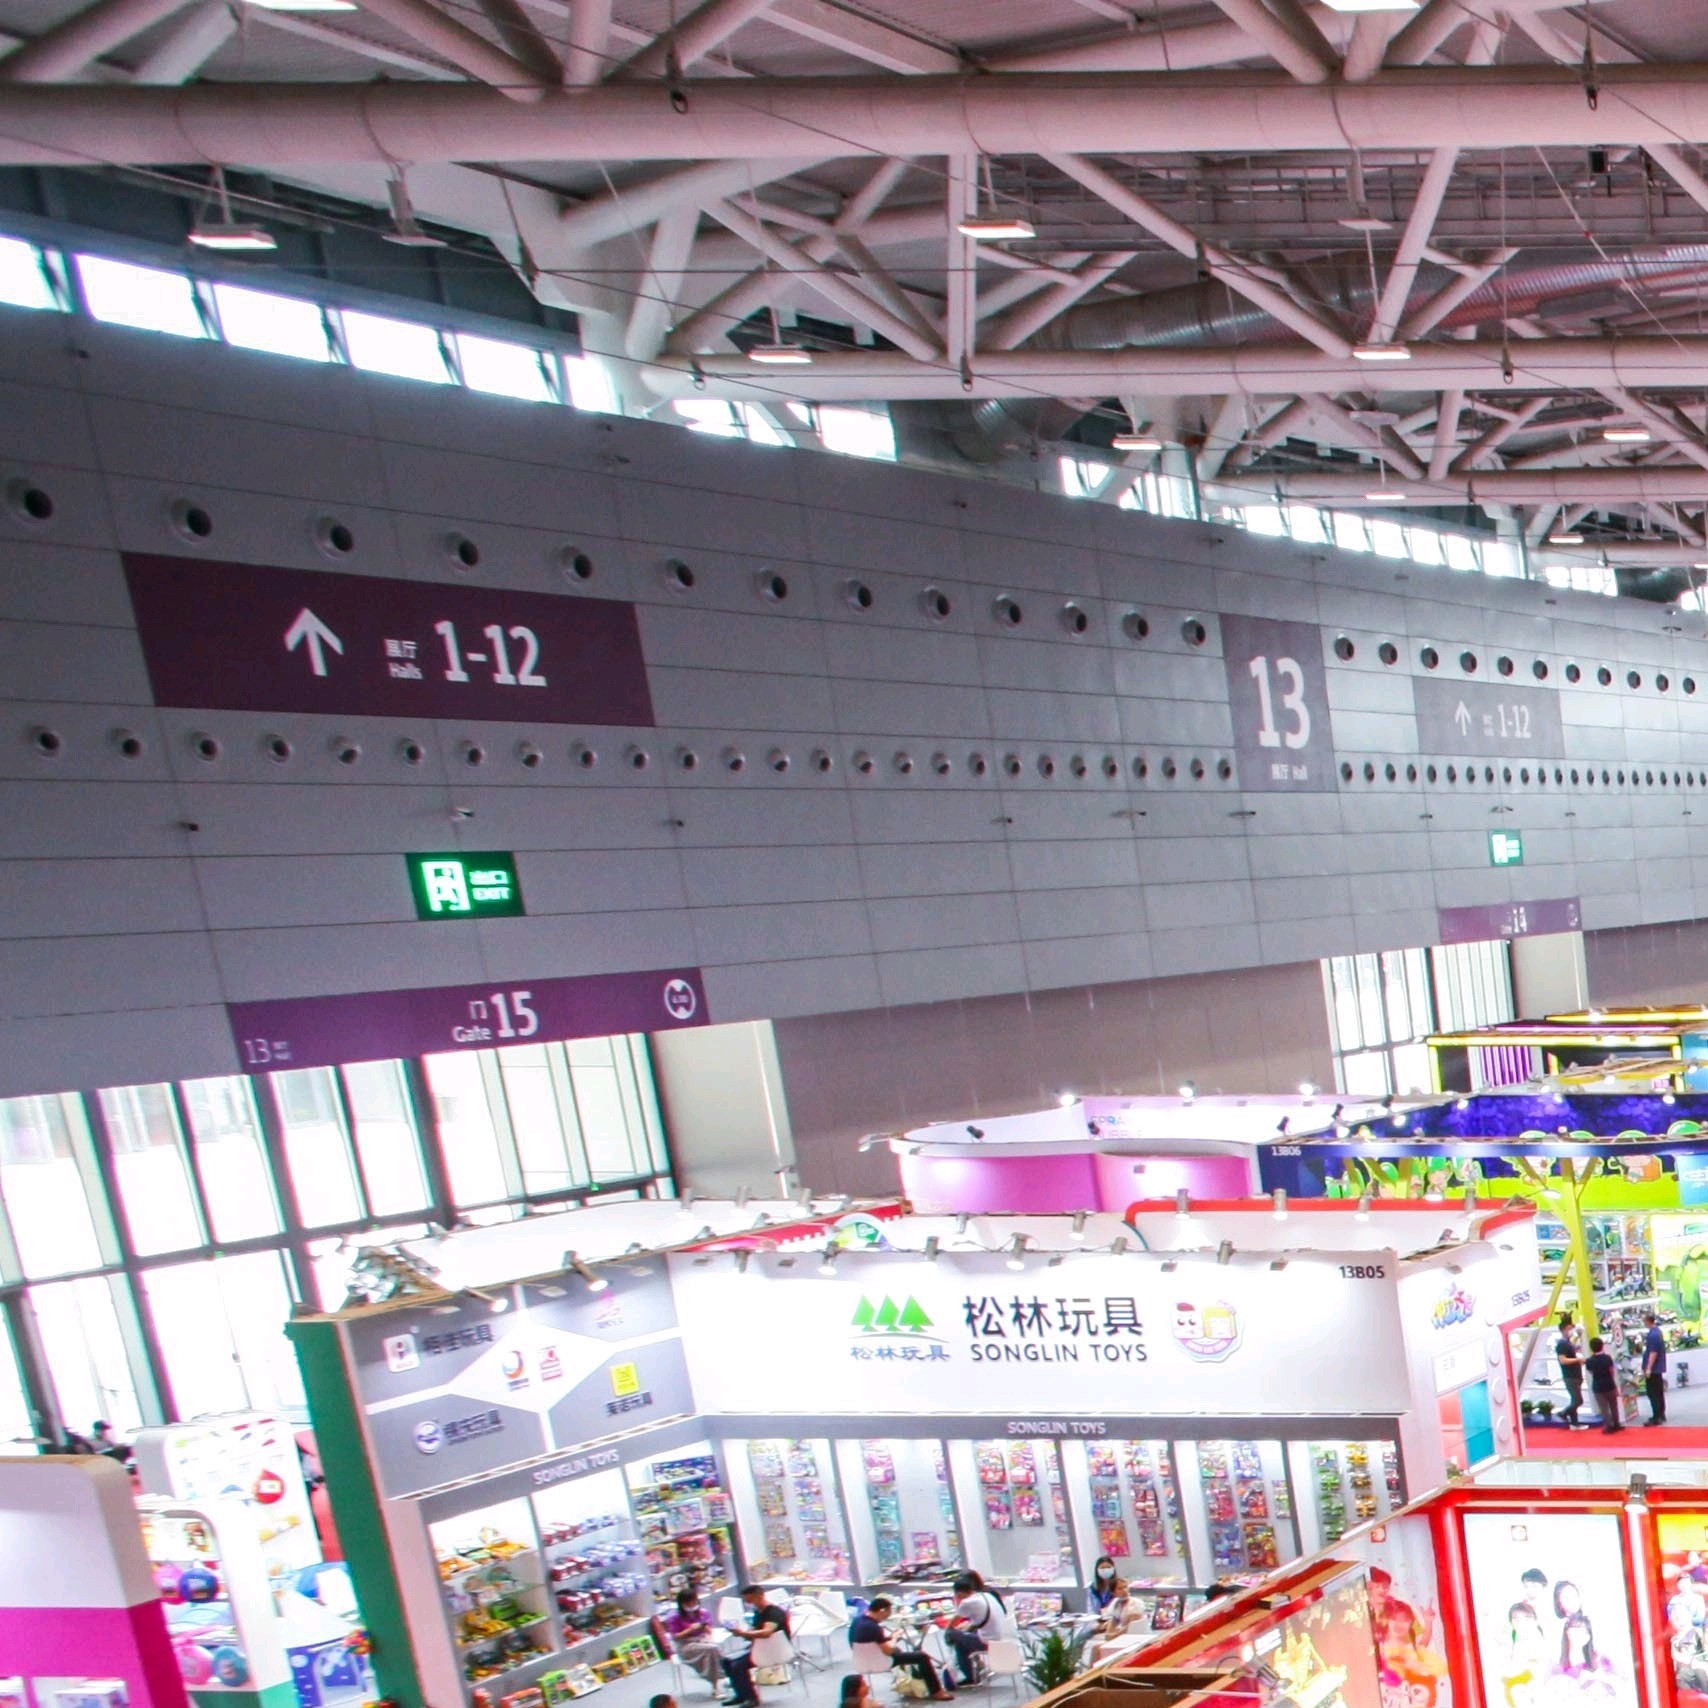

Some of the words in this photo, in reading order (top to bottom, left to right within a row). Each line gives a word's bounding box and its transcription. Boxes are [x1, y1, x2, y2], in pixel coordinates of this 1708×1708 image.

[436, 620, 548, 689] 1-12
[1249, 655, 1311, 751] 13
[1498, 703, 1532, 739] 1-12
[472, 886, 511, 902] EXIT
[453, 1024, 492, 1045] Gate
[496, 991, 540, 1040] 15
[1338, 1264, 1386, 1280] 13B05
[962, 1295, 1144, 1338] 松林玩具
[849, 1343, 951, 1362] 松林玩具
[972, 1342, 1078, 1363] SONGLIN
[1089, 1342, 1148, 1363] TOYS
[1007, 1420, 1067, 1437] SONGLIN
[1069, 1420, 1107, 1437] TOYS
[531, 1456, 590, 1487] SONGLIN
[589, 1448, 620, 1470] TOYS
